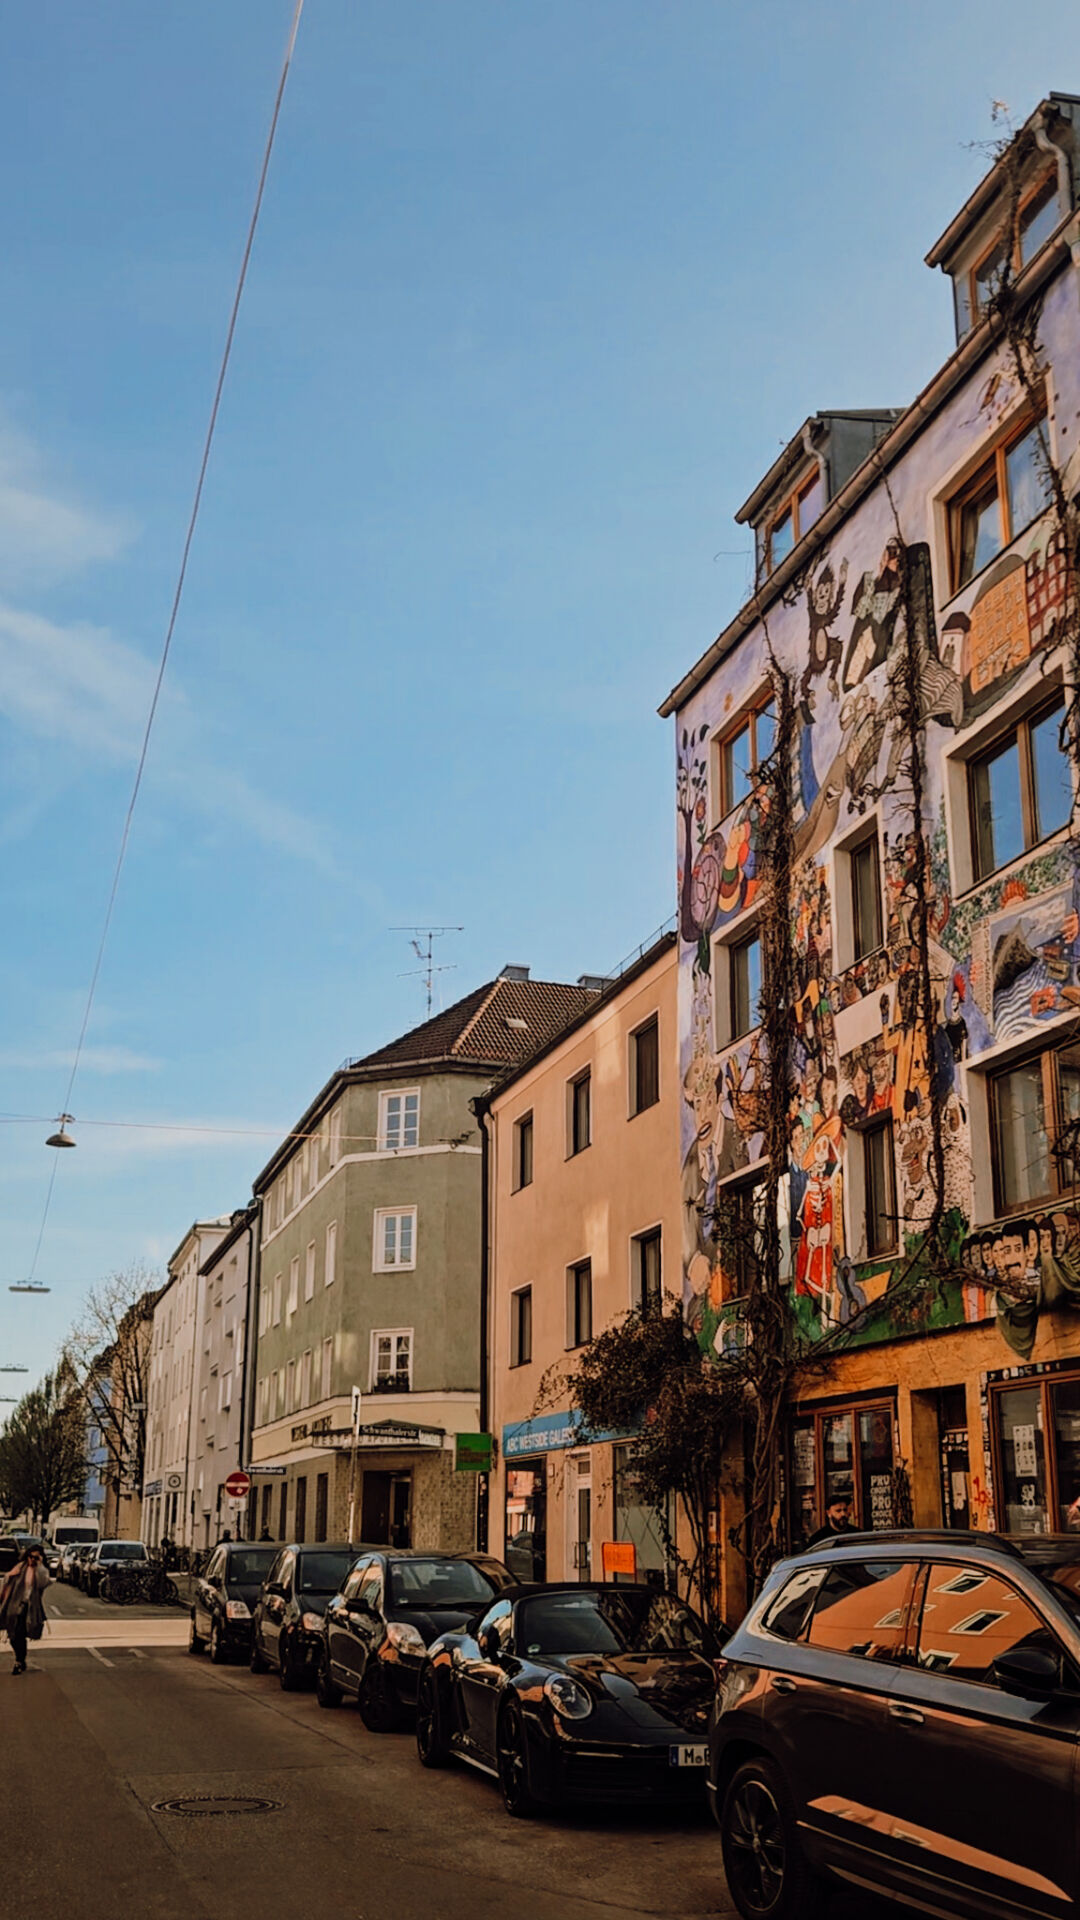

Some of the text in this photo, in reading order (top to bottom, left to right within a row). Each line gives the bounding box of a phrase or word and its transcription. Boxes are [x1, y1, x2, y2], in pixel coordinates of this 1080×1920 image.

[507, 1437, 519, 1453] ABC
[520, 1431, 548, 1450] WESTSIDE
[872, 1496, 891, 1510] PRO
